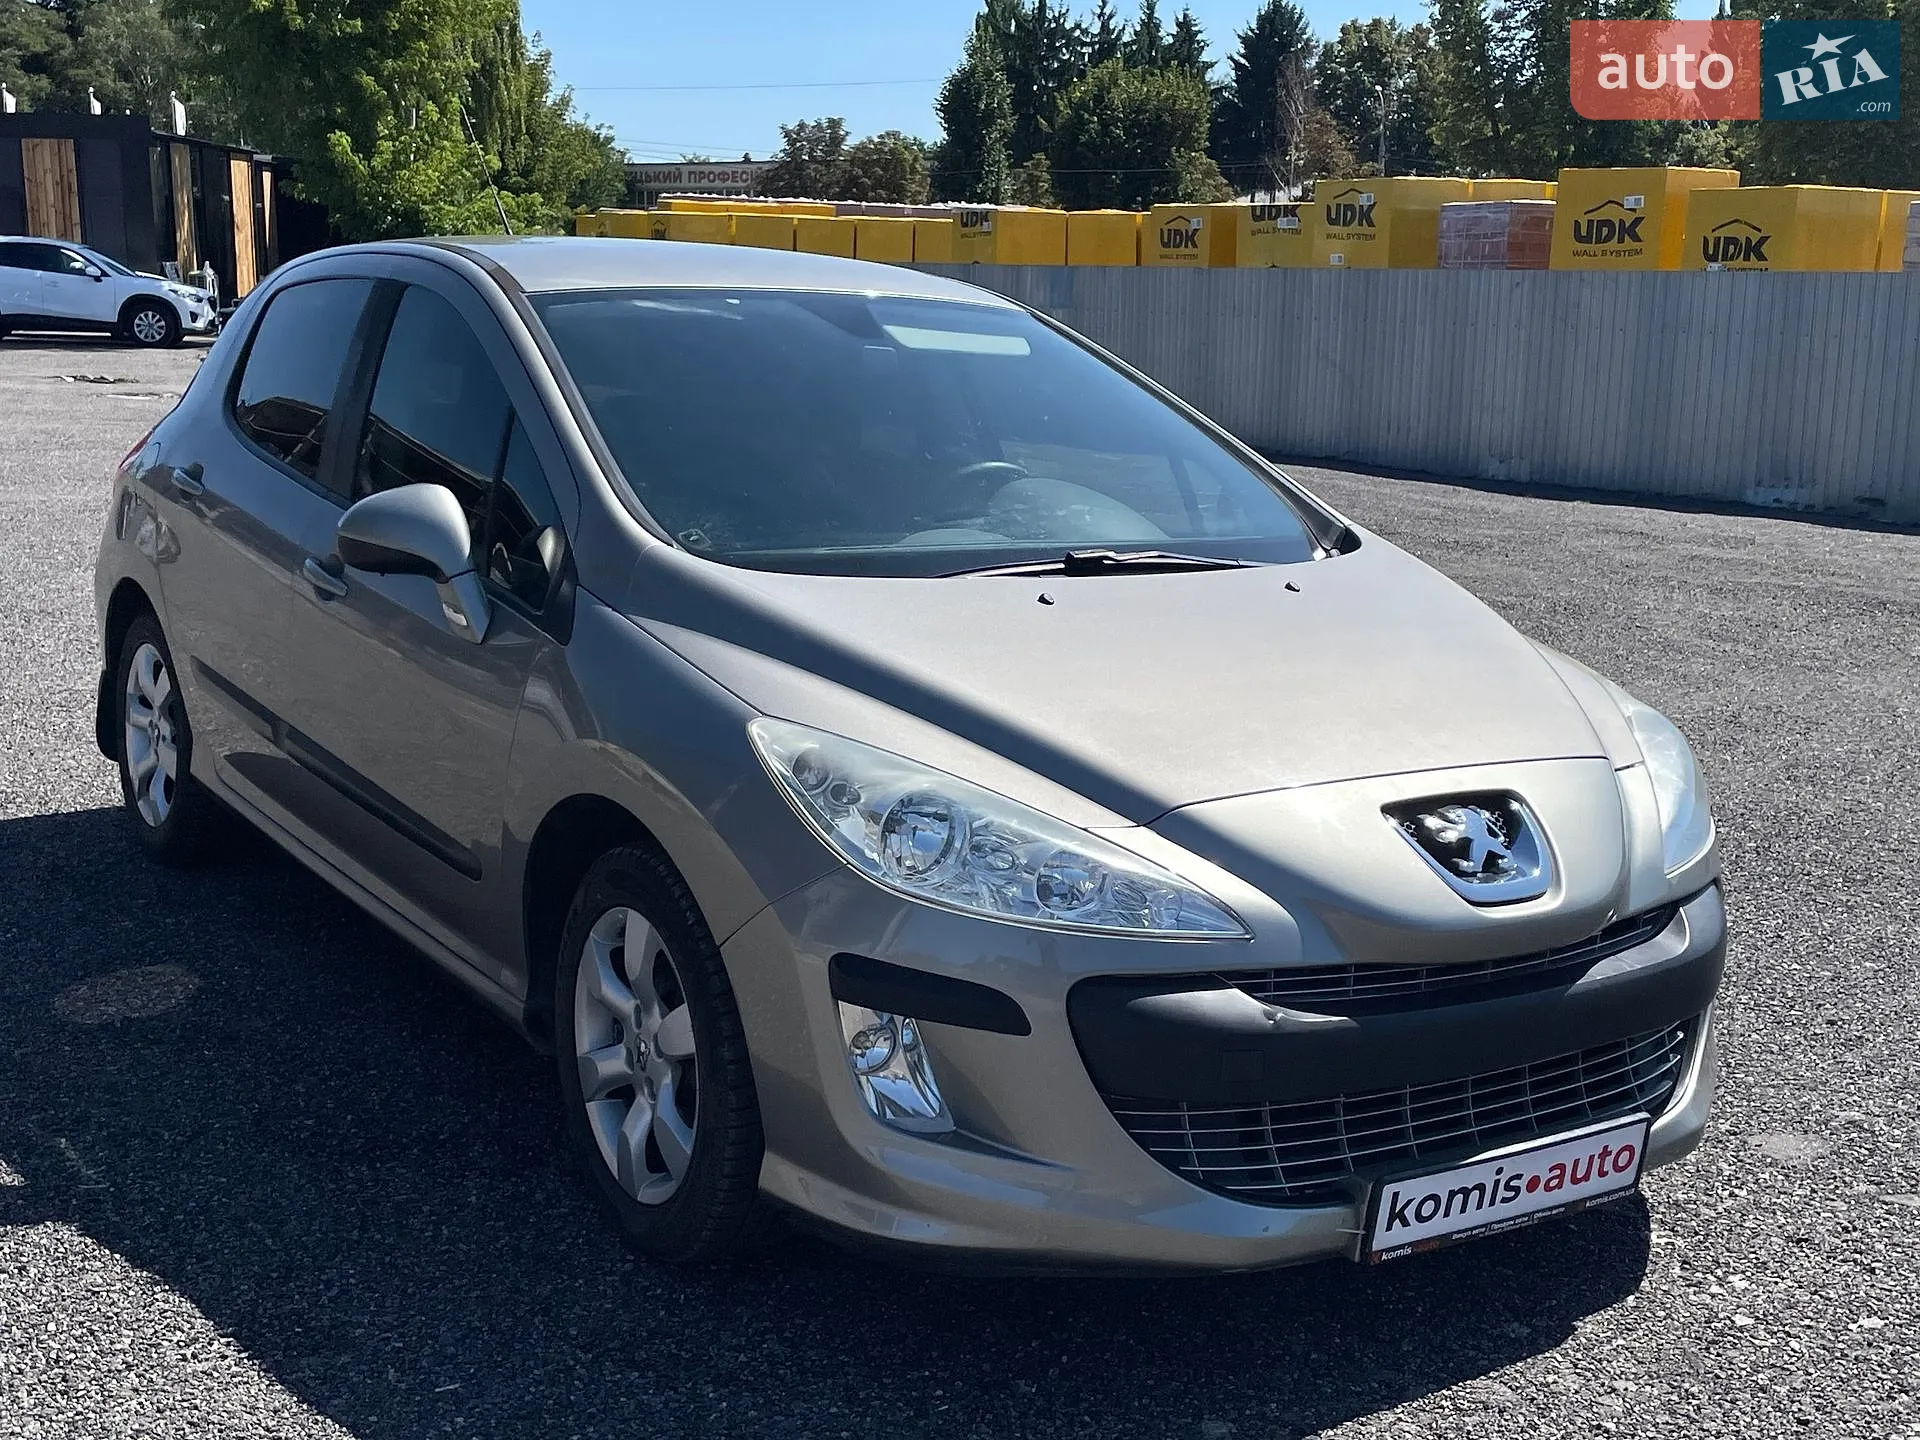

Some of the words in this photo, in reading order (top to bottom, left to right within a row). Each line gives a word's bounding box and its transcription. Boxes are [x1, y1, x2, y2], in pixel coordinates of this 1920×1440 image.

[1251, 205, 1302, 223] UDK
[1326, 202, 1378, 228] UDK
[1160, 228, 1200, 249] UDK
[1573, 216, 1646, 244] UDK
[1572, 249, 1598, 258] WALL
[1600, 248, 1643, 258] SYSTEM
[1702, 235, 1773, 262] UDK
